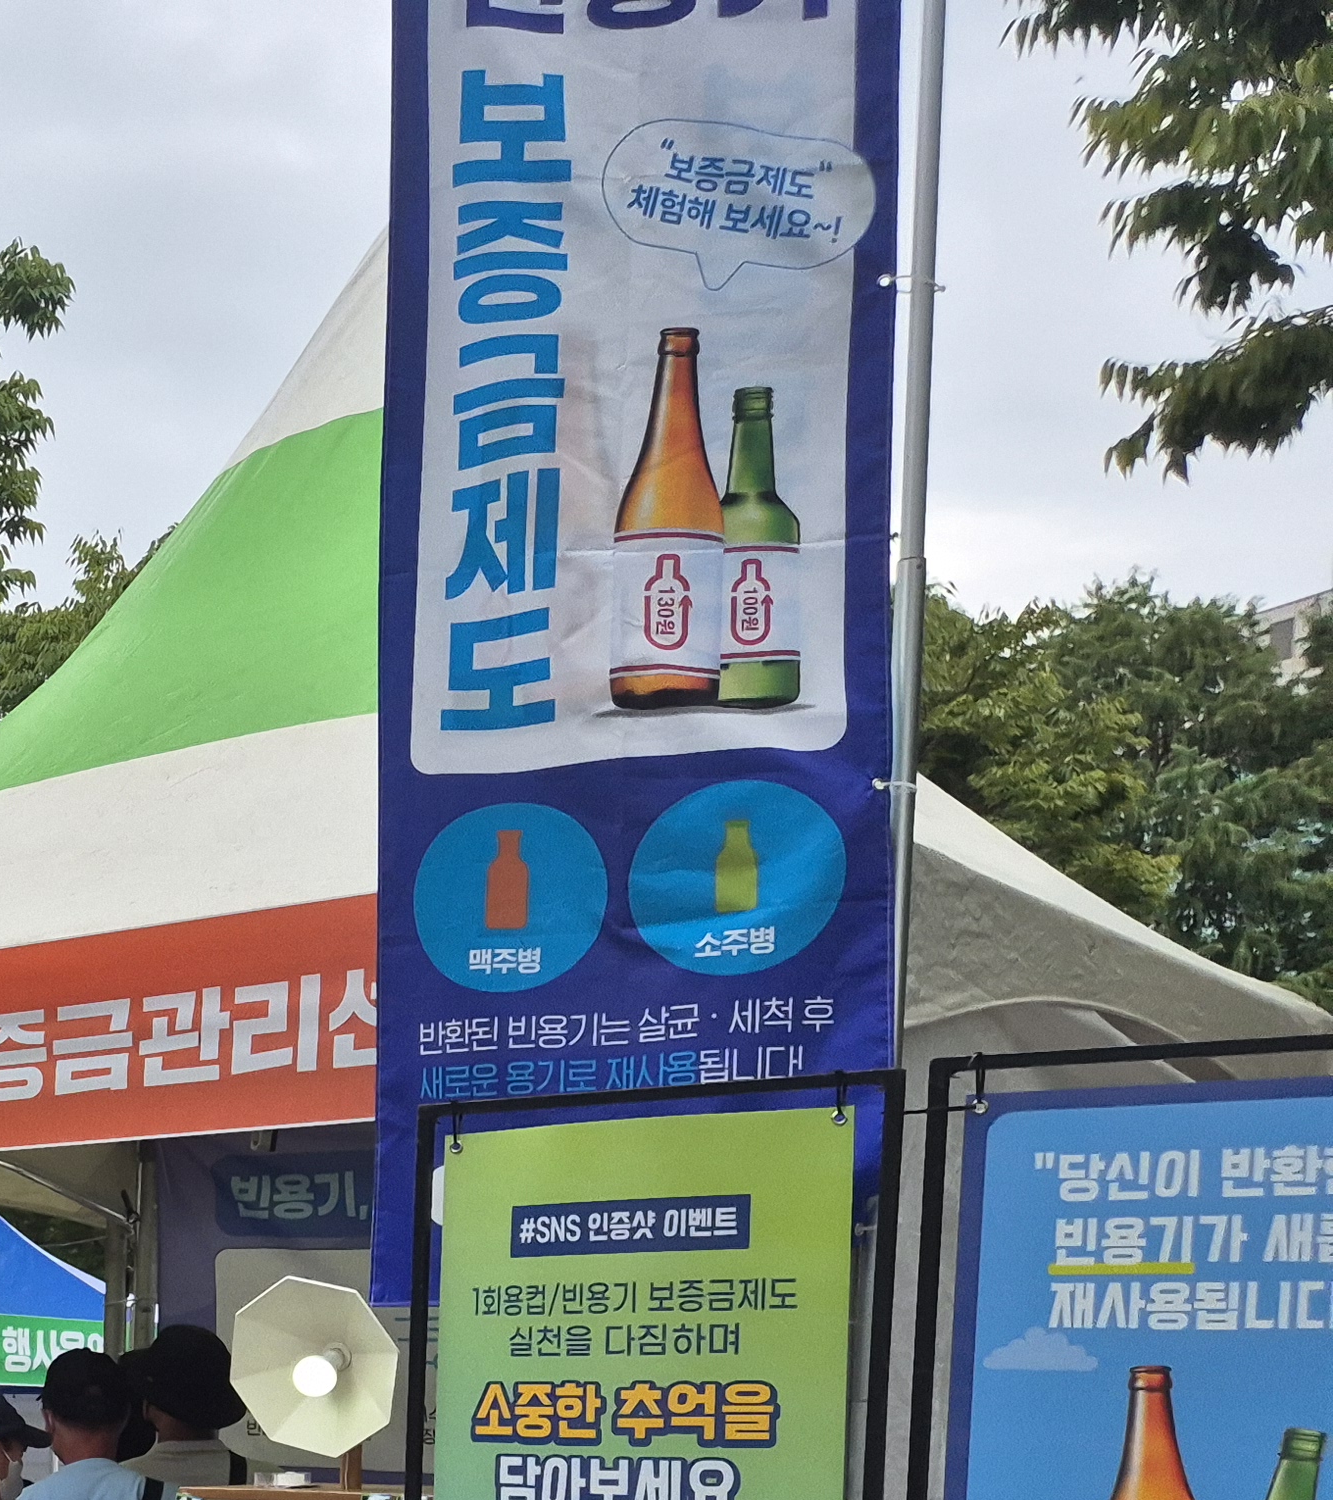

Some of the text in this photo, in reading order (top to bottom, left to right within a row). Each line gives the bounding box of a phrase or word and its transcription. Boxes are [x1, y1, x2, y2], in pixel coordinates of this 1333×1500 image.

[628, 183, 843, 244] 체험해 보세요~!
[440, 69, 572, 732] 보증금제도
[654, 585, 677, 638] 130원
[741, 586, 761, 634] 100원
[467, 946, 543, 974] 맥주병
[693, 925, 776, 960] 소주병
[417, 995, 835, 1056] 반환된 빈용기는 살균 세척 후
[419, 1062, 498, 1101] 새로운
[505, 1056, 598, 1096] 용기로
[1220, 1144, 1333, 1199] 반환
[519, 1206, 739, 1245] #SNS 인증샷 이벤트
[1054, 1213, 1250, 1267] 빈용기가
[471, 1277, 799, 1318] 1회용컵/빈용기 보증금제도
[508, 1321, 742, 1358] 실천을 다짐하며
[472, 1381, 605, 1443] 소중한
[614, 1381, 778, 1444] 추억을
